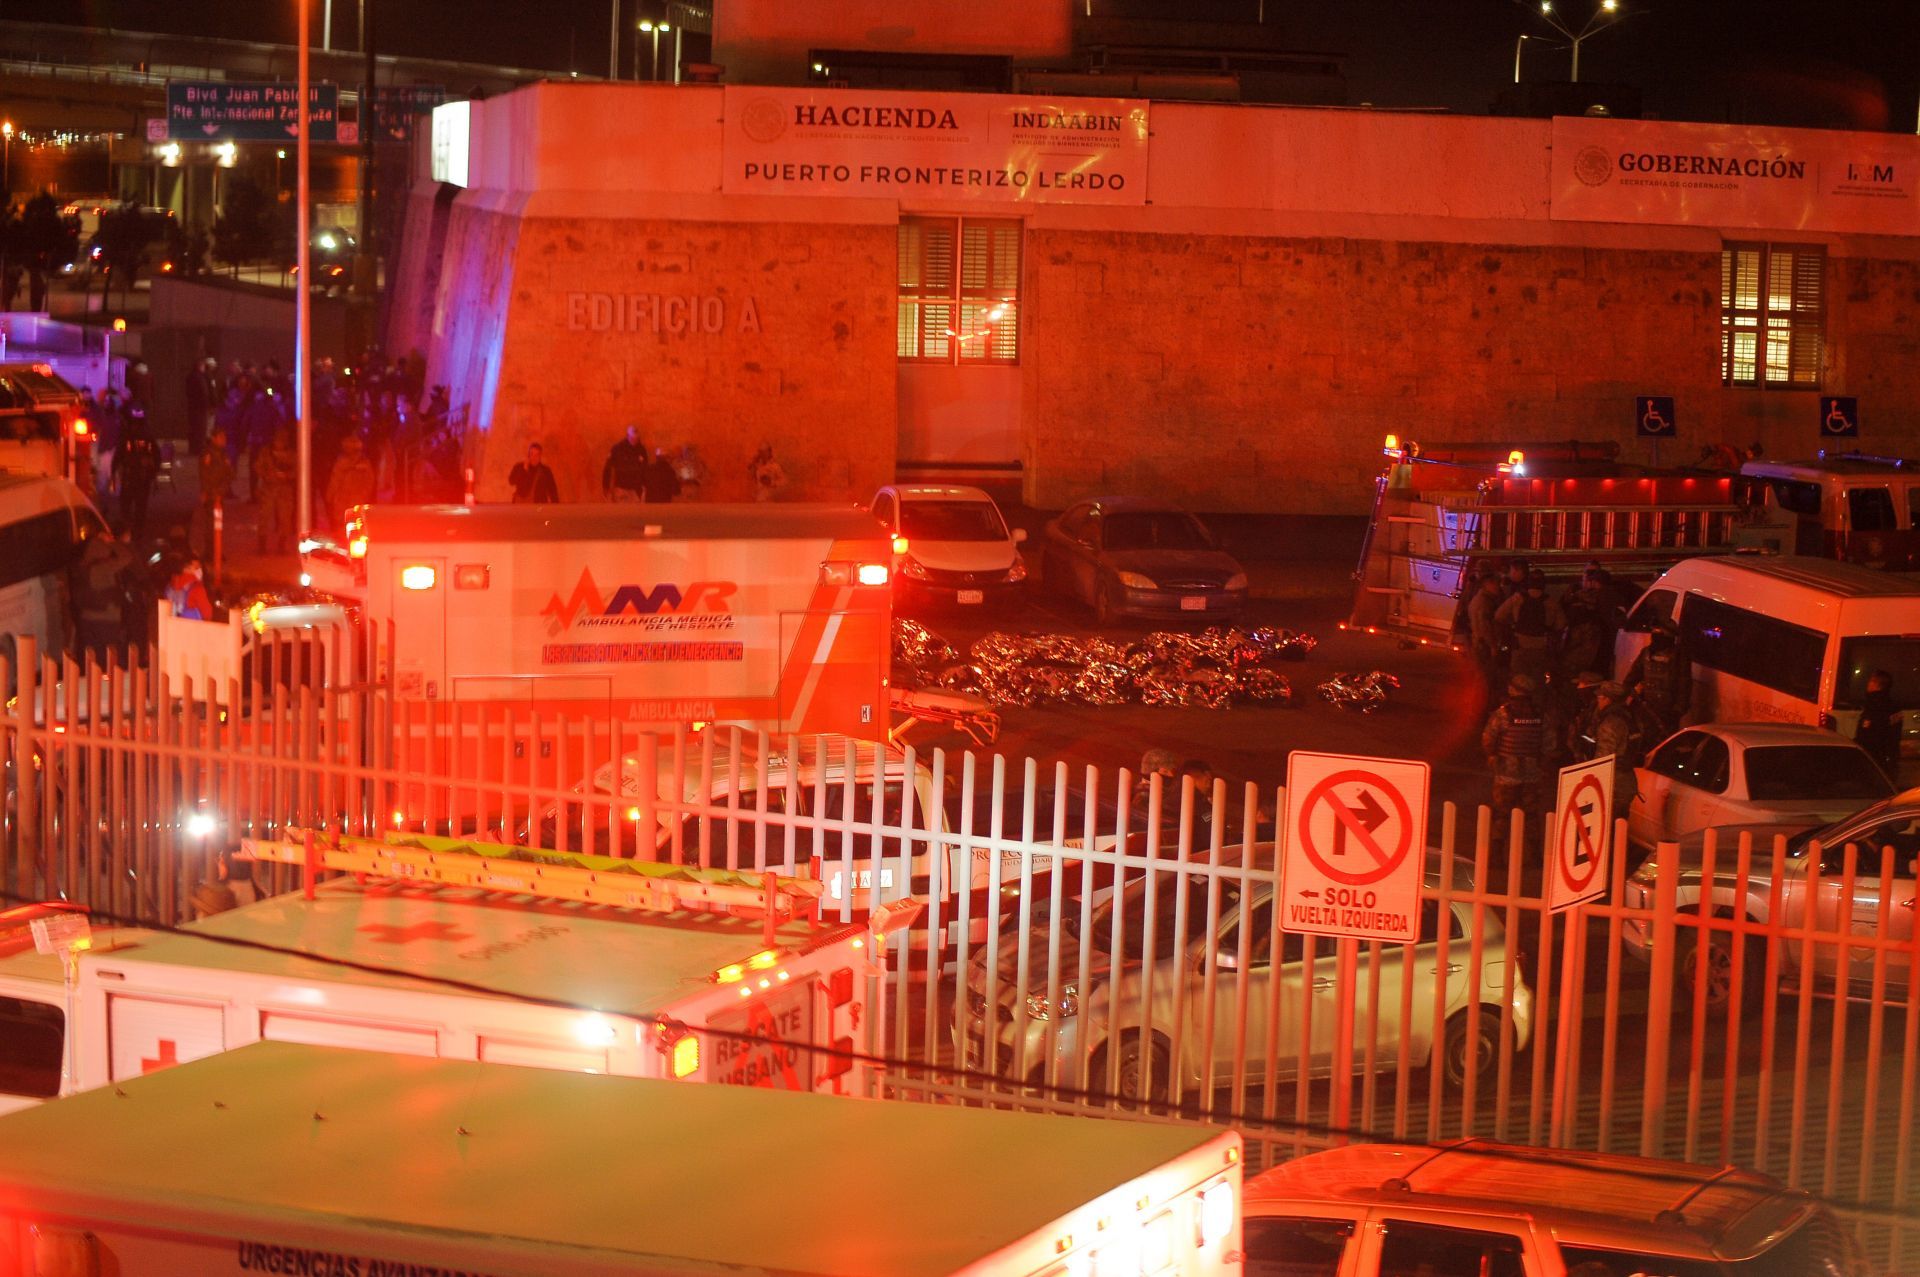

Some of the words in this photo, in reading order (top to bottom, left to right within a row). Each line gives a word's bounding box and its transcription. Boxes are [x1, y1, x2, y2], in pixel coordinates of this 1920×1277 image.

[187, 87, 217, 101] Blvd
[226, 87, 259, 102] Juan
[201, 105, 275, 120] Internacional
[280, 105, 332, 122] Zaroza
[794, 104, 959, 129] HACIENDA
[1012, 113, 1122, 131] INDAABIN
[744, 162, 850, 182] PUERTO
[860, 166, 1028, 187] FRONTERIZO
[1039, 171, 1125, 190] LERDO
[1618, 153, 1805, 179] GOBERNACIÓN
[568, 293, 726, 333] EDIFICIO
[737, 296, 763, 333] A
[577, 615, 673, 627] AMBULANCIA
[645, 623, 666, 631] DE
[669, 621, 736, 630] RESCATE
[628, 702, 716, 720] AMBULANCIA
[1324, 887, 1377, 909] SOLO
[1290, 904, 1338, 926] VUELTA
[1341, 909, 1408, 932] IZQUIERDA
[716, 1005, 801, 1065] RESCATE
[238, 1240, 360, 1277] URGENCIAS
